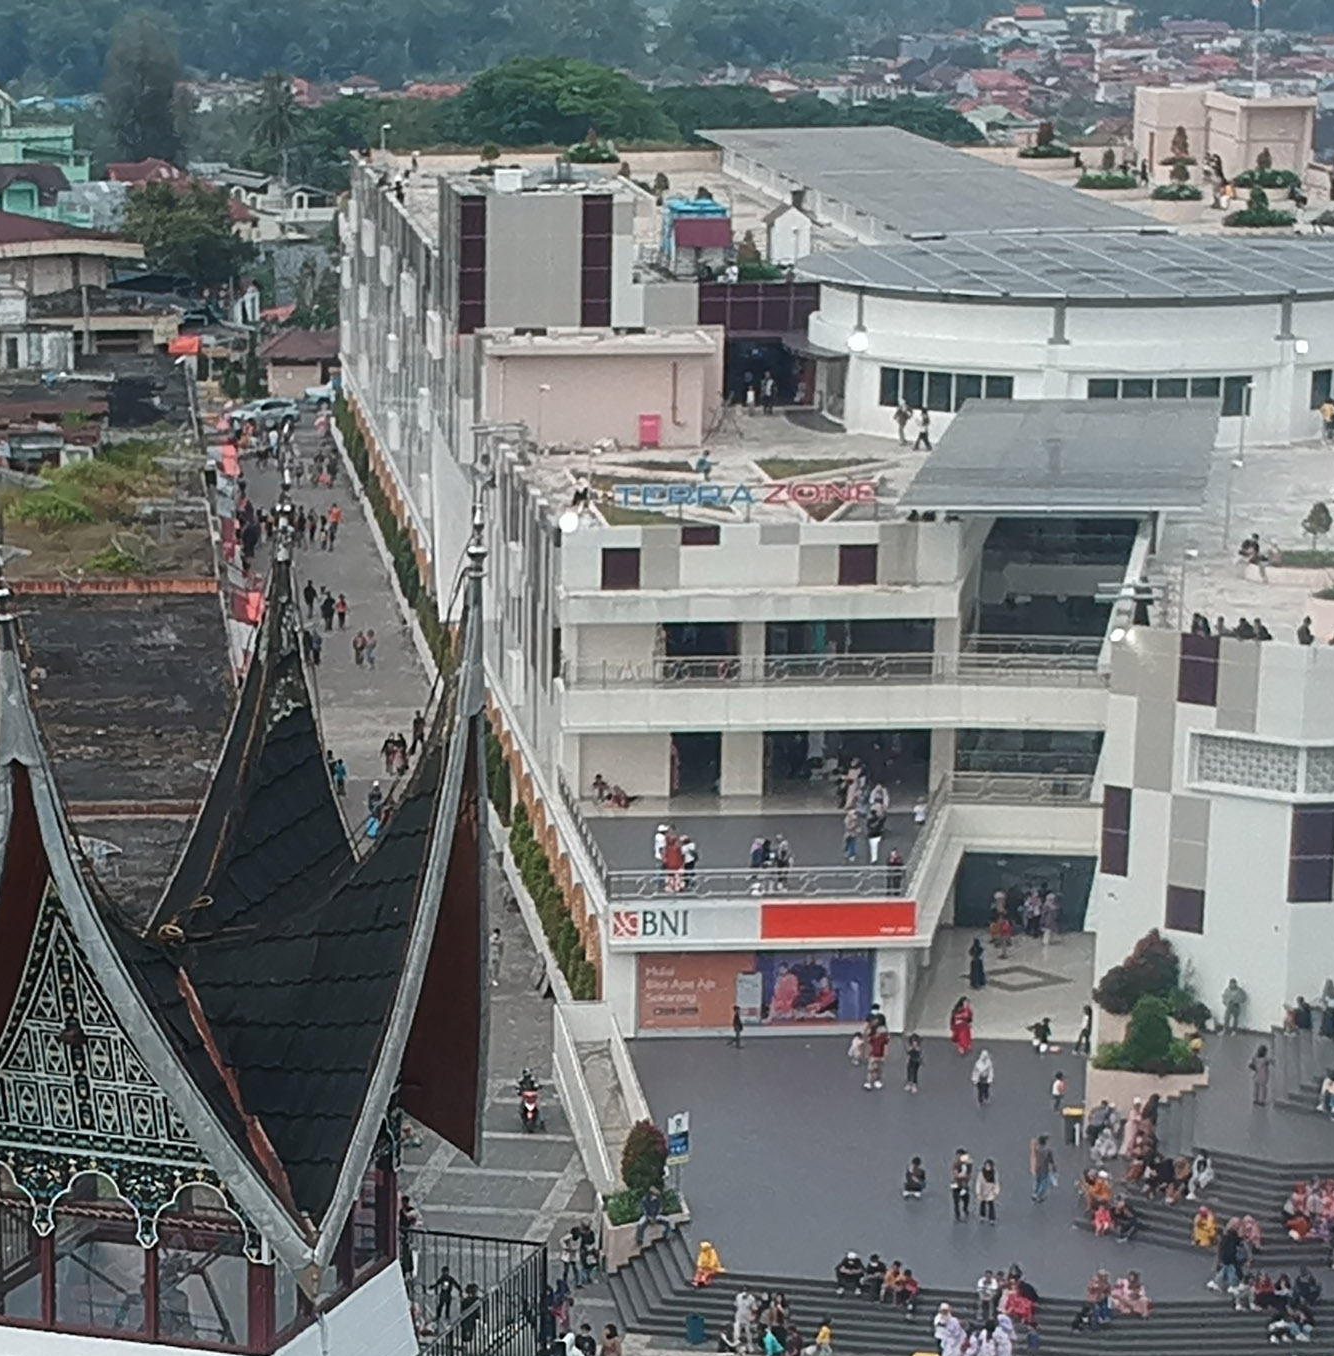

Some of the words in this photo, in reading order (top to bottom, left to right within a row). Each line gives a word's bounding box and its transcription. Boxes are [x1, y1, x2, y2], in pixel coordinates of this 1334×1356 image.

[615, 484, 755, 507] TERRA
[764, 482, 878, 504] ZONE
[641, 910, 689, 936] BNI
